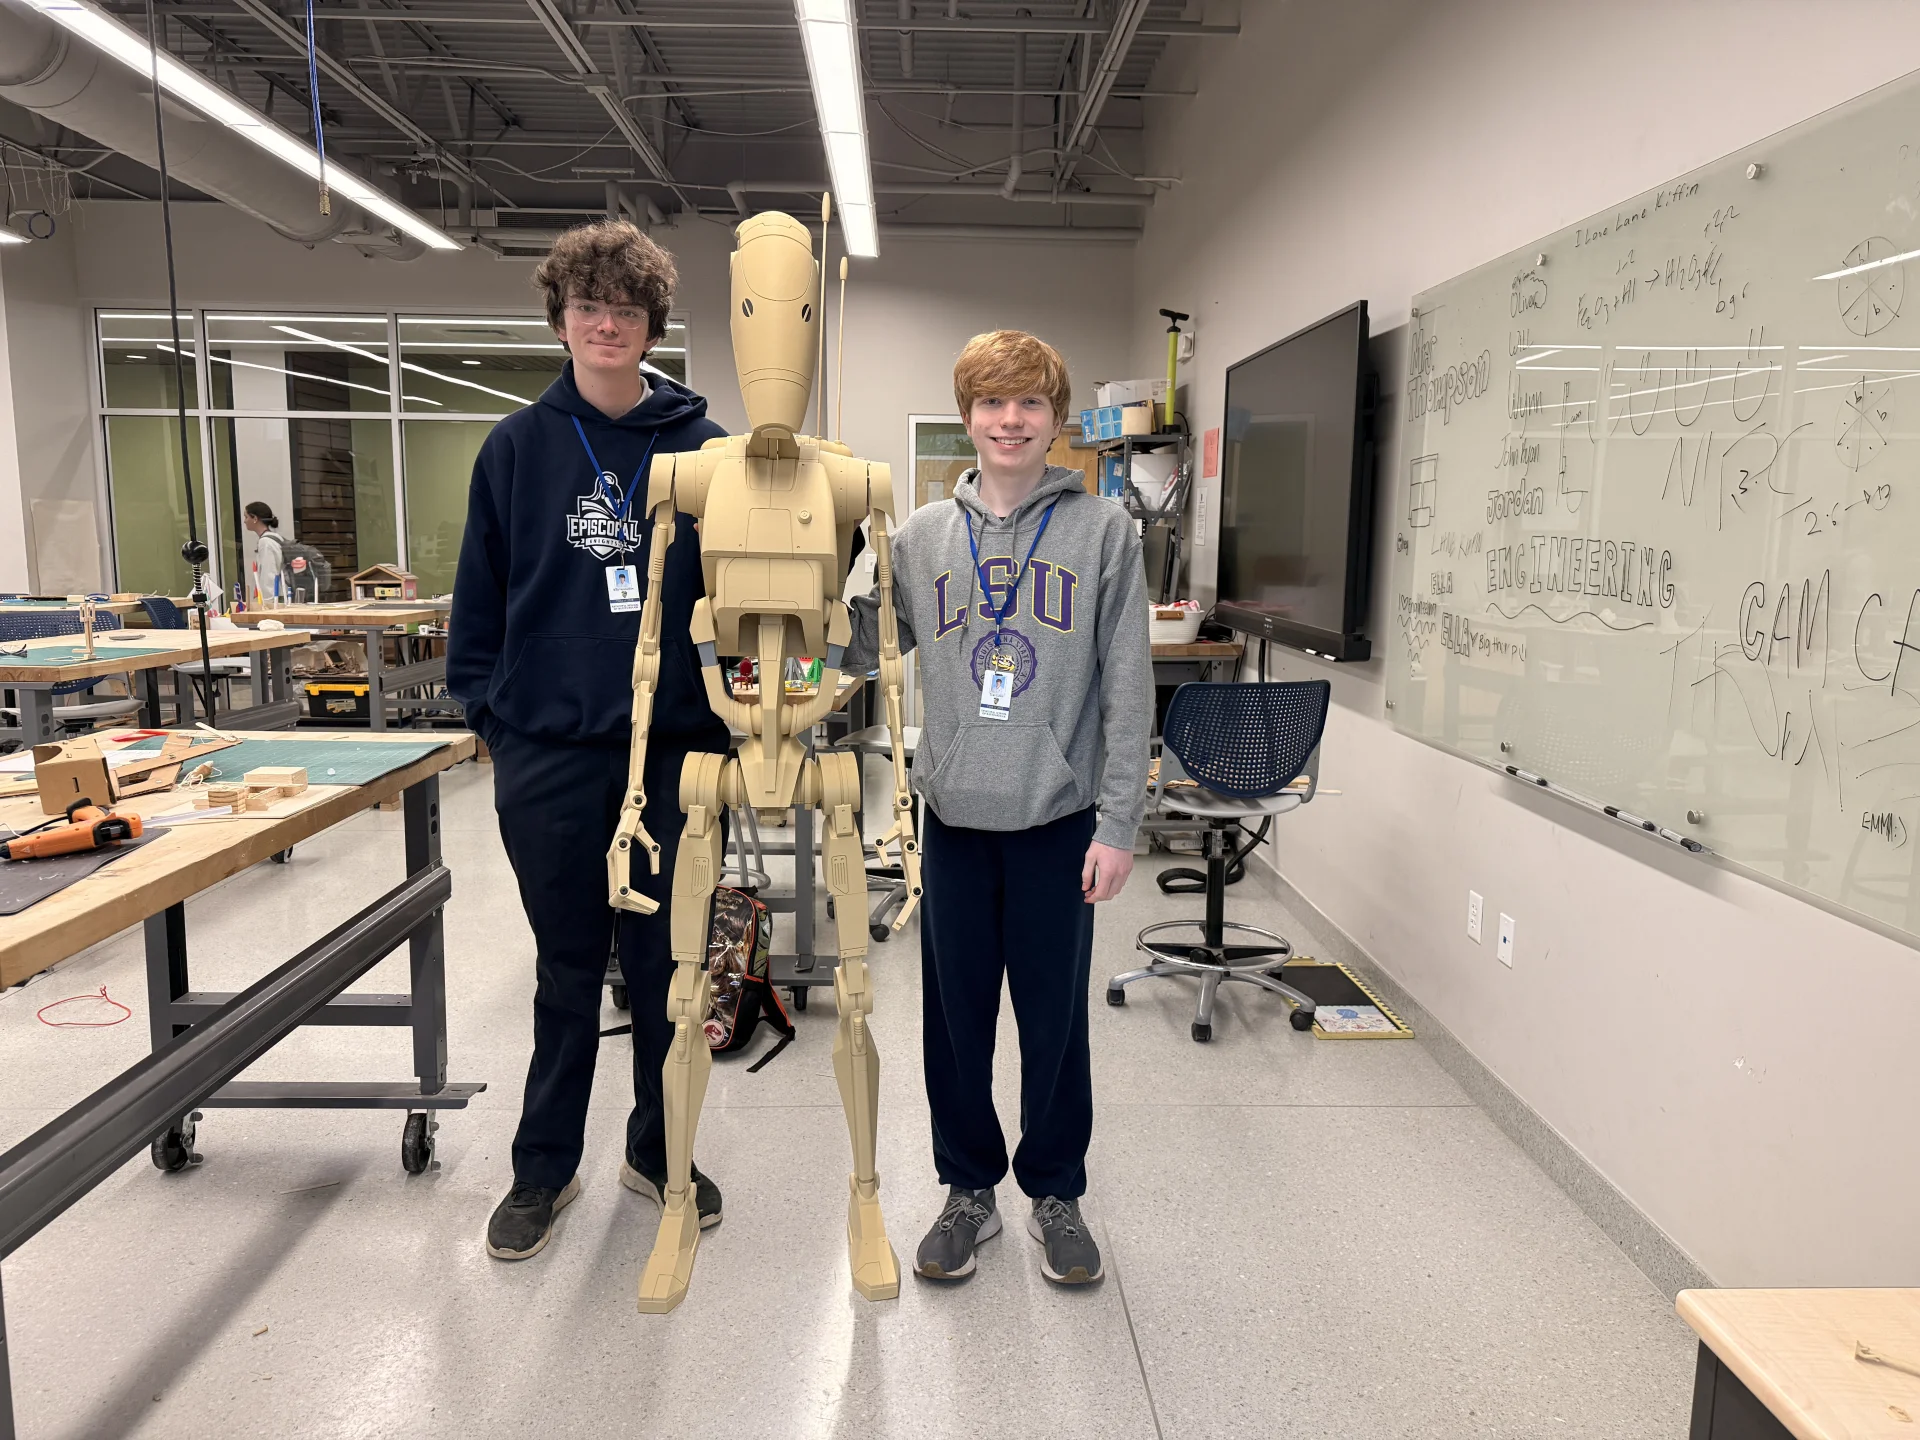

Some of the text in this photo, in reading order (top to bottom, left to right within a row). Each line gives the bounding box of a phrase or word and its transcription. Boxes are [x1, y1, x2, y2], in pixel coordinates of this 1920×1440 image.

[1574, 229, 1582, 248] I
[1615, 208, 1647, 231] Lane
[1654, 183, 1699, 212] Kiffin
[1407, 348, 1491, 427] Thompson
[1486, 477, 1544, 525] Jordan
[569, 517, 639, 543] EPISCOPAL
[1430, 571, 1453, 596] ELLA
[1486, 535, 1676, 609] ENGINEERING
[934, 556, 1078, 641] LSU
[977, 634, 1031, 666] LOUISNA STATE
[1440, 611, 1471, 658] ELLA
